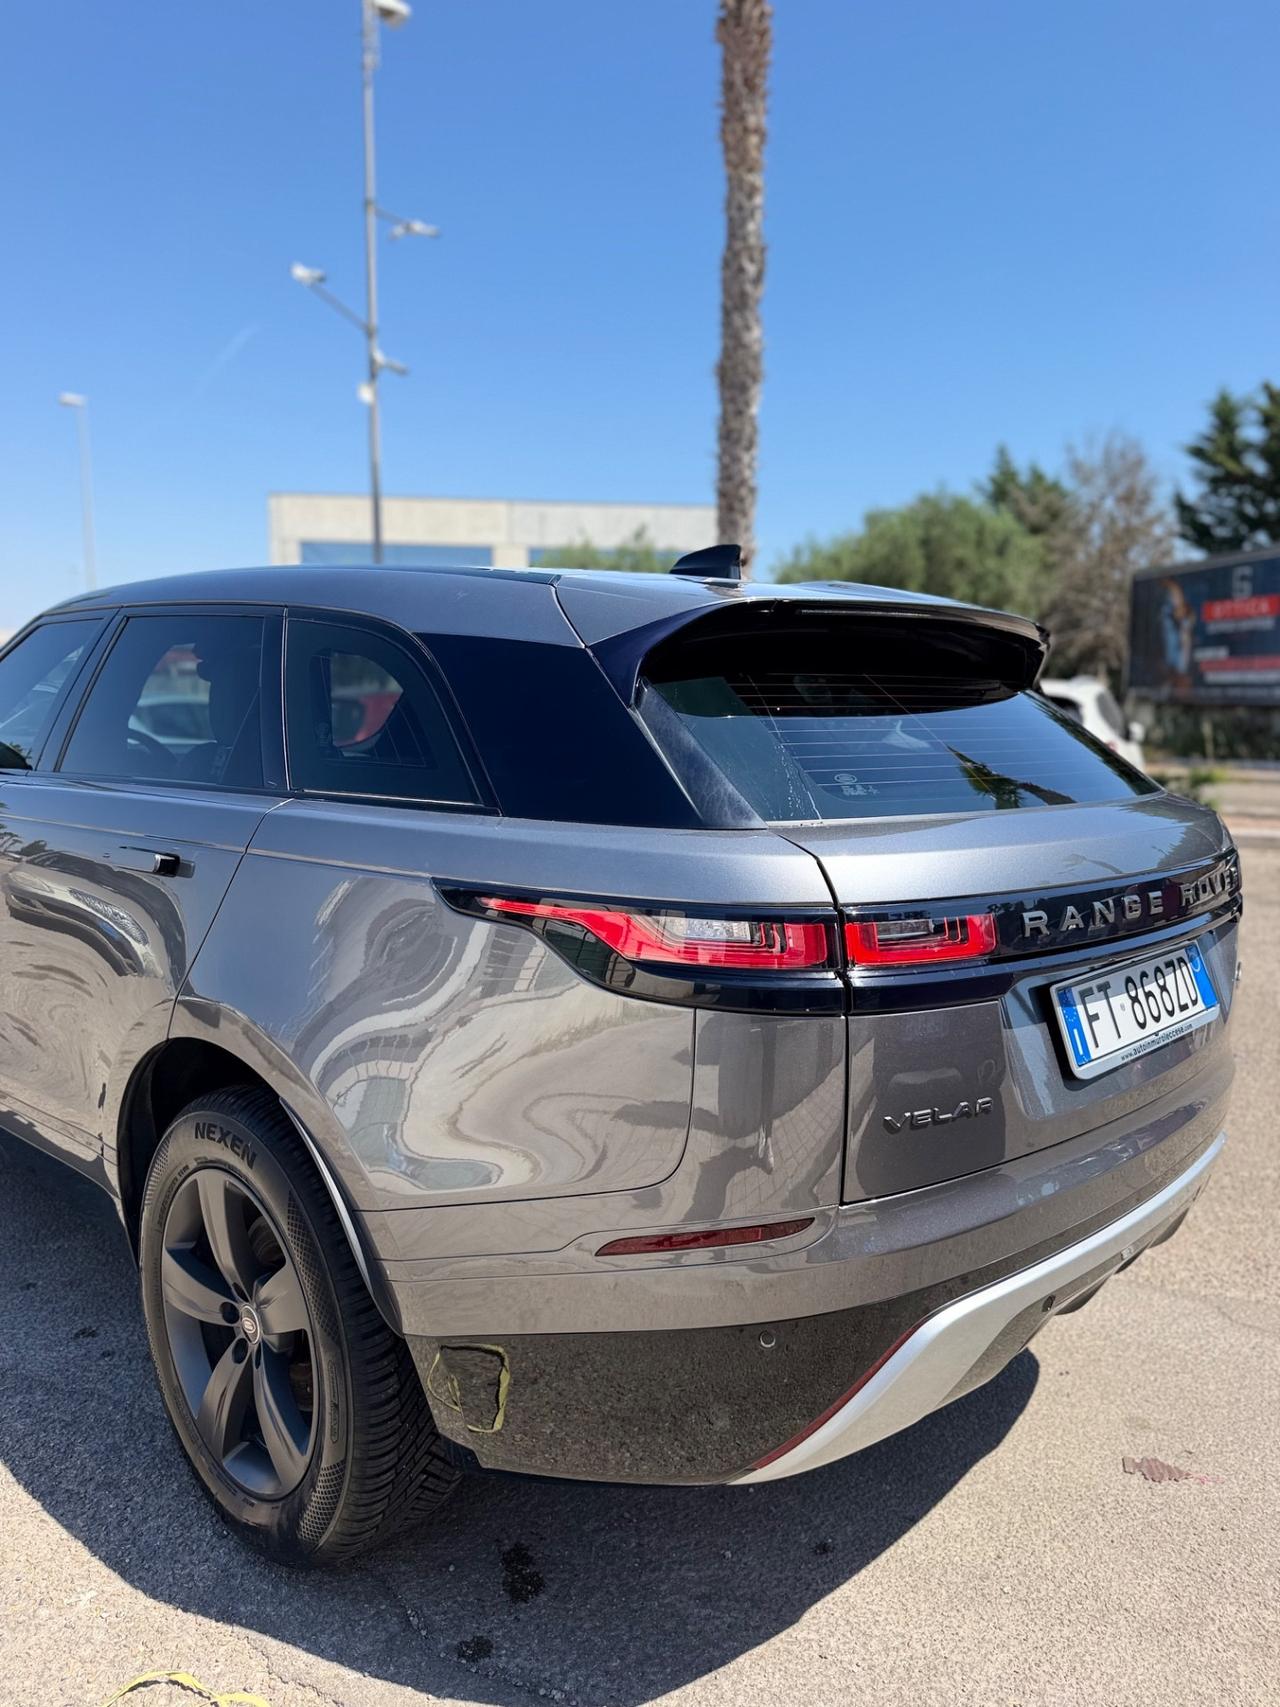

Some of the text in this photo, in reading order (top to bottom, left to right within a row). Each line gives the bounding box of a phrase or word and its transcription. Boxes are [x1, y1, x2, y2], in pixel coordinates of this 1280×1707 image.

[1022, 891, 1164, 938] RANGE
[1079, 956, 1198, 1048] FT 868ZD
[883, 1097, 993, 1131] VELAR
[195, 1122, 257, 1169] NEXEN
